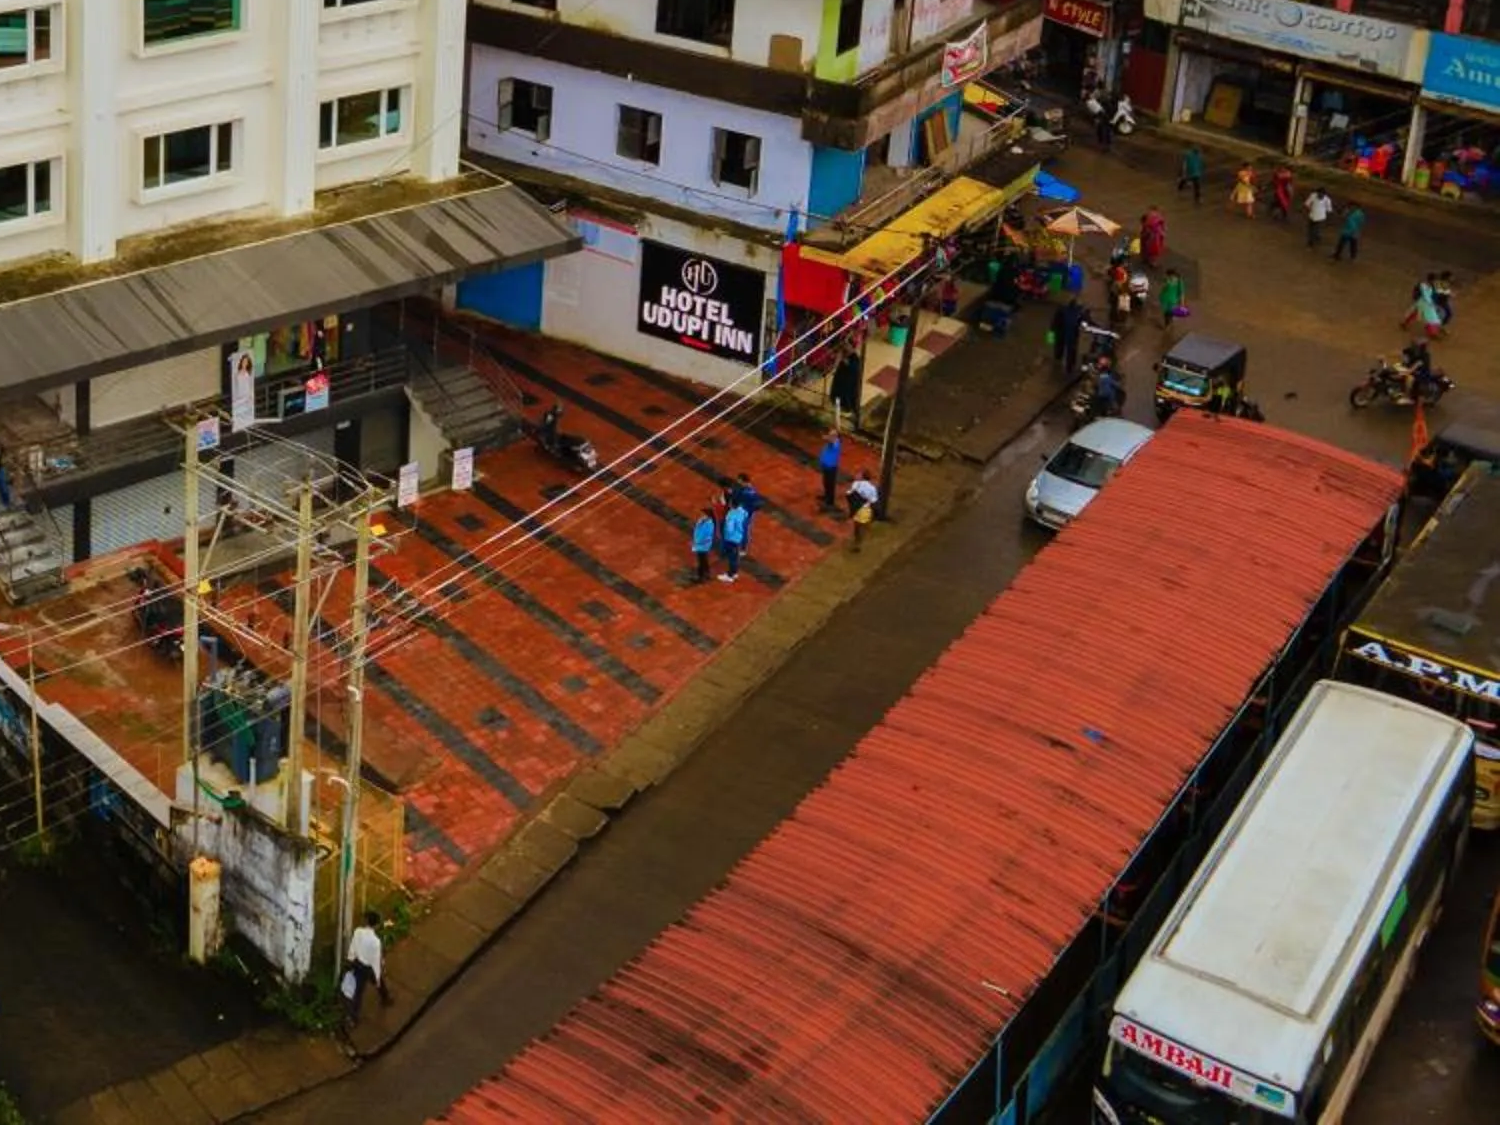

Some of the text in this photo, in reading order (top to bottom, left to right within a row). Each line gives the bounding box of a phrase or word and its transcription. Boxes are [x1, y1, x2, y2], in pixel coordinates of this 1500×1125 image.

[643, 301, 753, 354] UDUPI INN
[661, 286, 734, 326] HOTEL
[1122, 1023, 1233, 1089] AMBAJI
